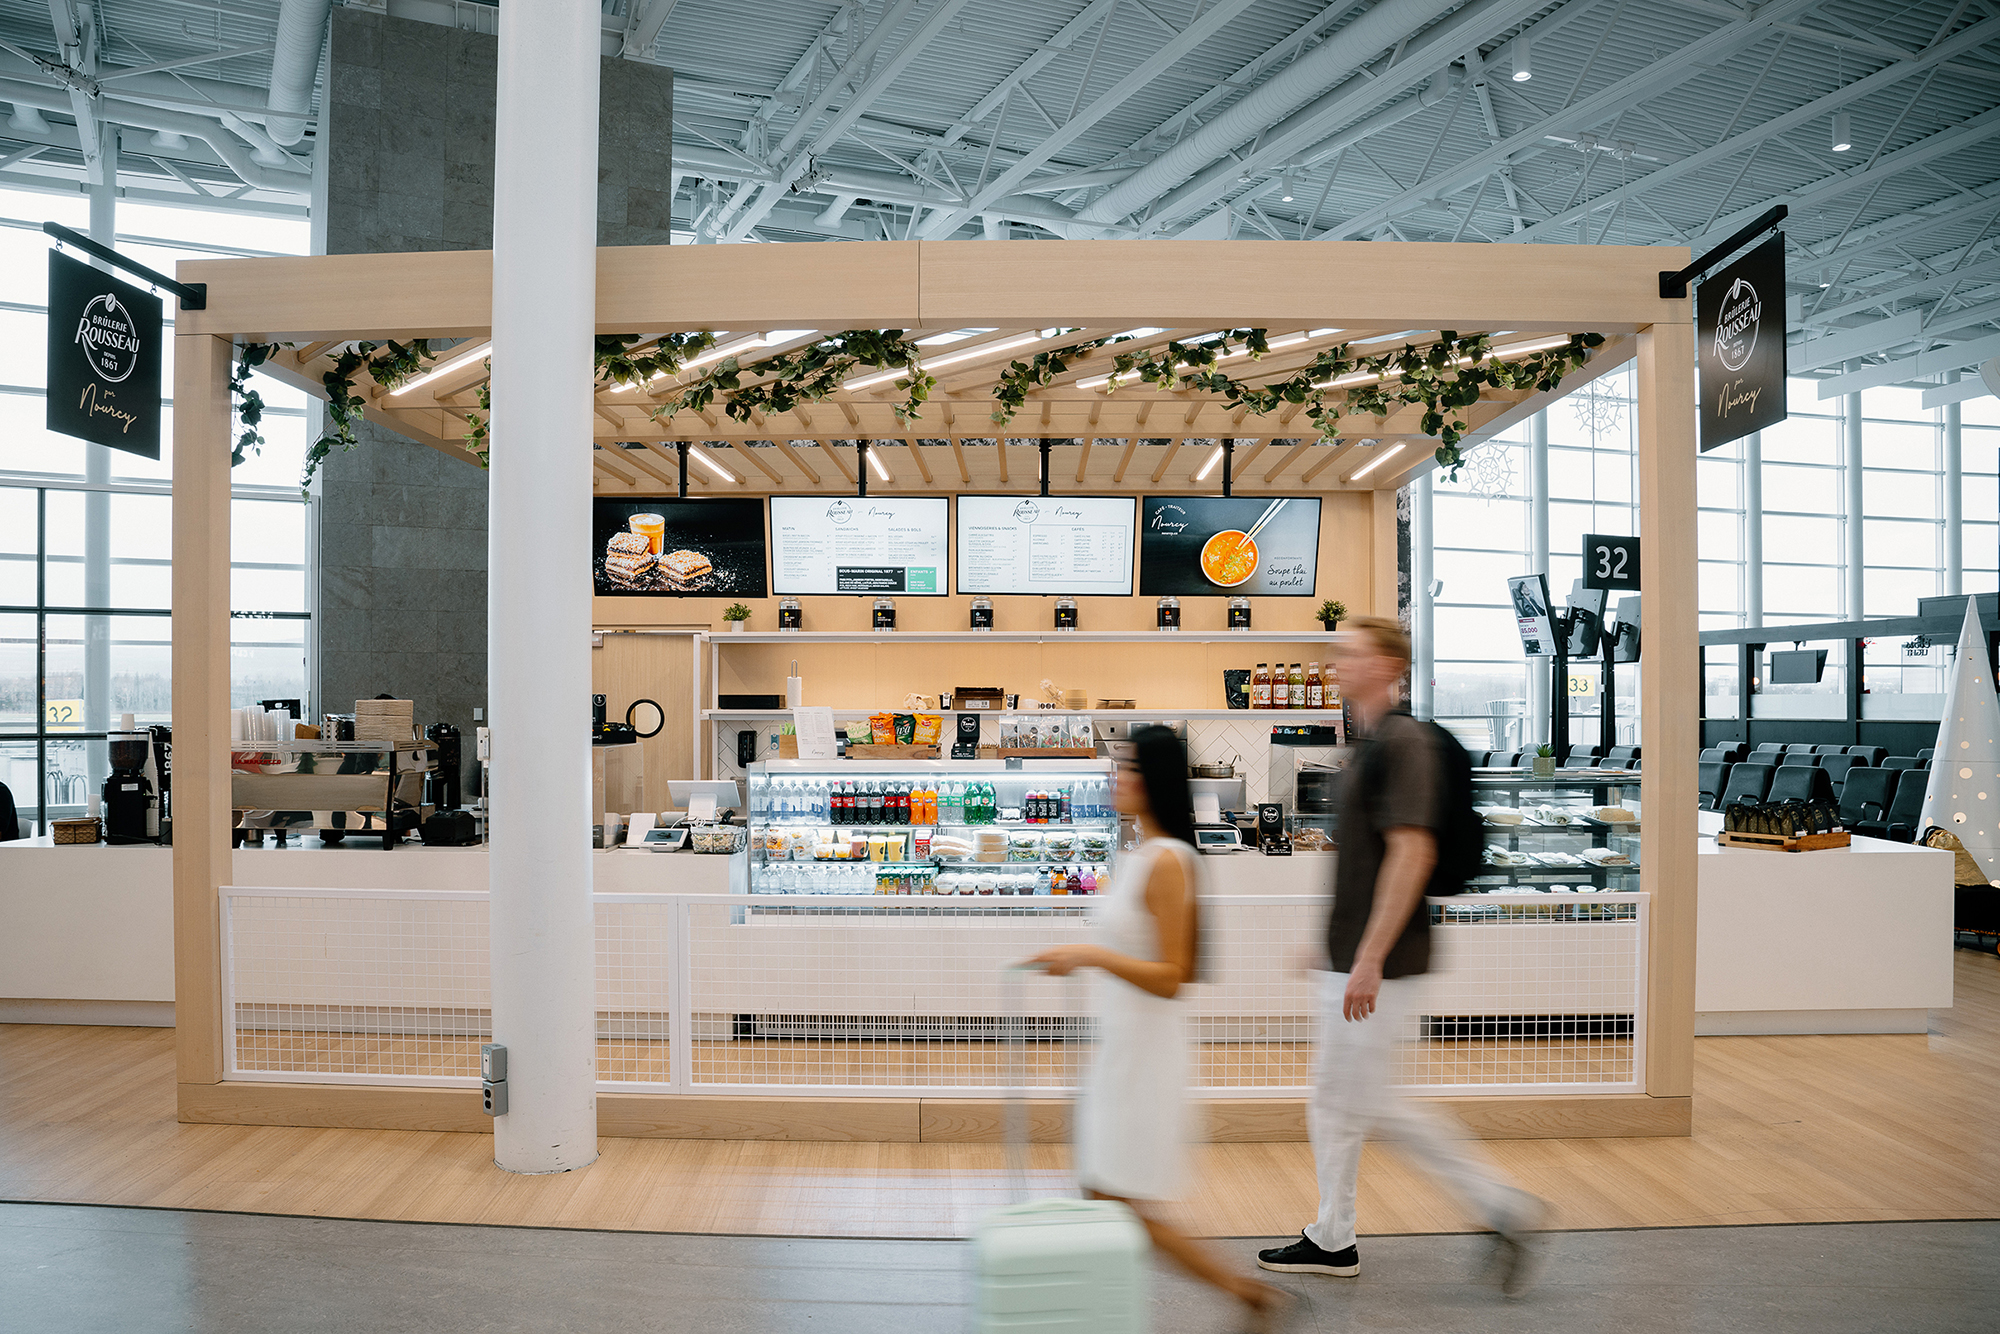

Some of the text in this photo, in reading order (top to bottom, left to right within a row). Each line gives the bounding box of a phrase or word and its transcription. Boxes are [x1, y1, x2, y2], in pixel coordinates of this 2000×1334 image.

[1724, 296, 1751, 325] BRÛLERIE
[92, 314, 128, 333] BRÛLERIE
[1713, 301, 1762, 357] ROUSSEAU
[74, 317, 140, 354] ROUSSEAU
[101, 357, 118, 371] 1867
[103, 388, 116, 399] par
[1717, 382, 1762, 418] Nourcy
[79, 382, 137, 434] Nourcy
[1151, 514, 1190, 533] Nourcy
[1267, 563, 1290, 577] Soupe
[1595, 545, 1629, 579] 32
[1279, 576, 1304, 588] poulet
[1569, 678, 1589, 692] 33
[47, 706, 73, 723] 32
